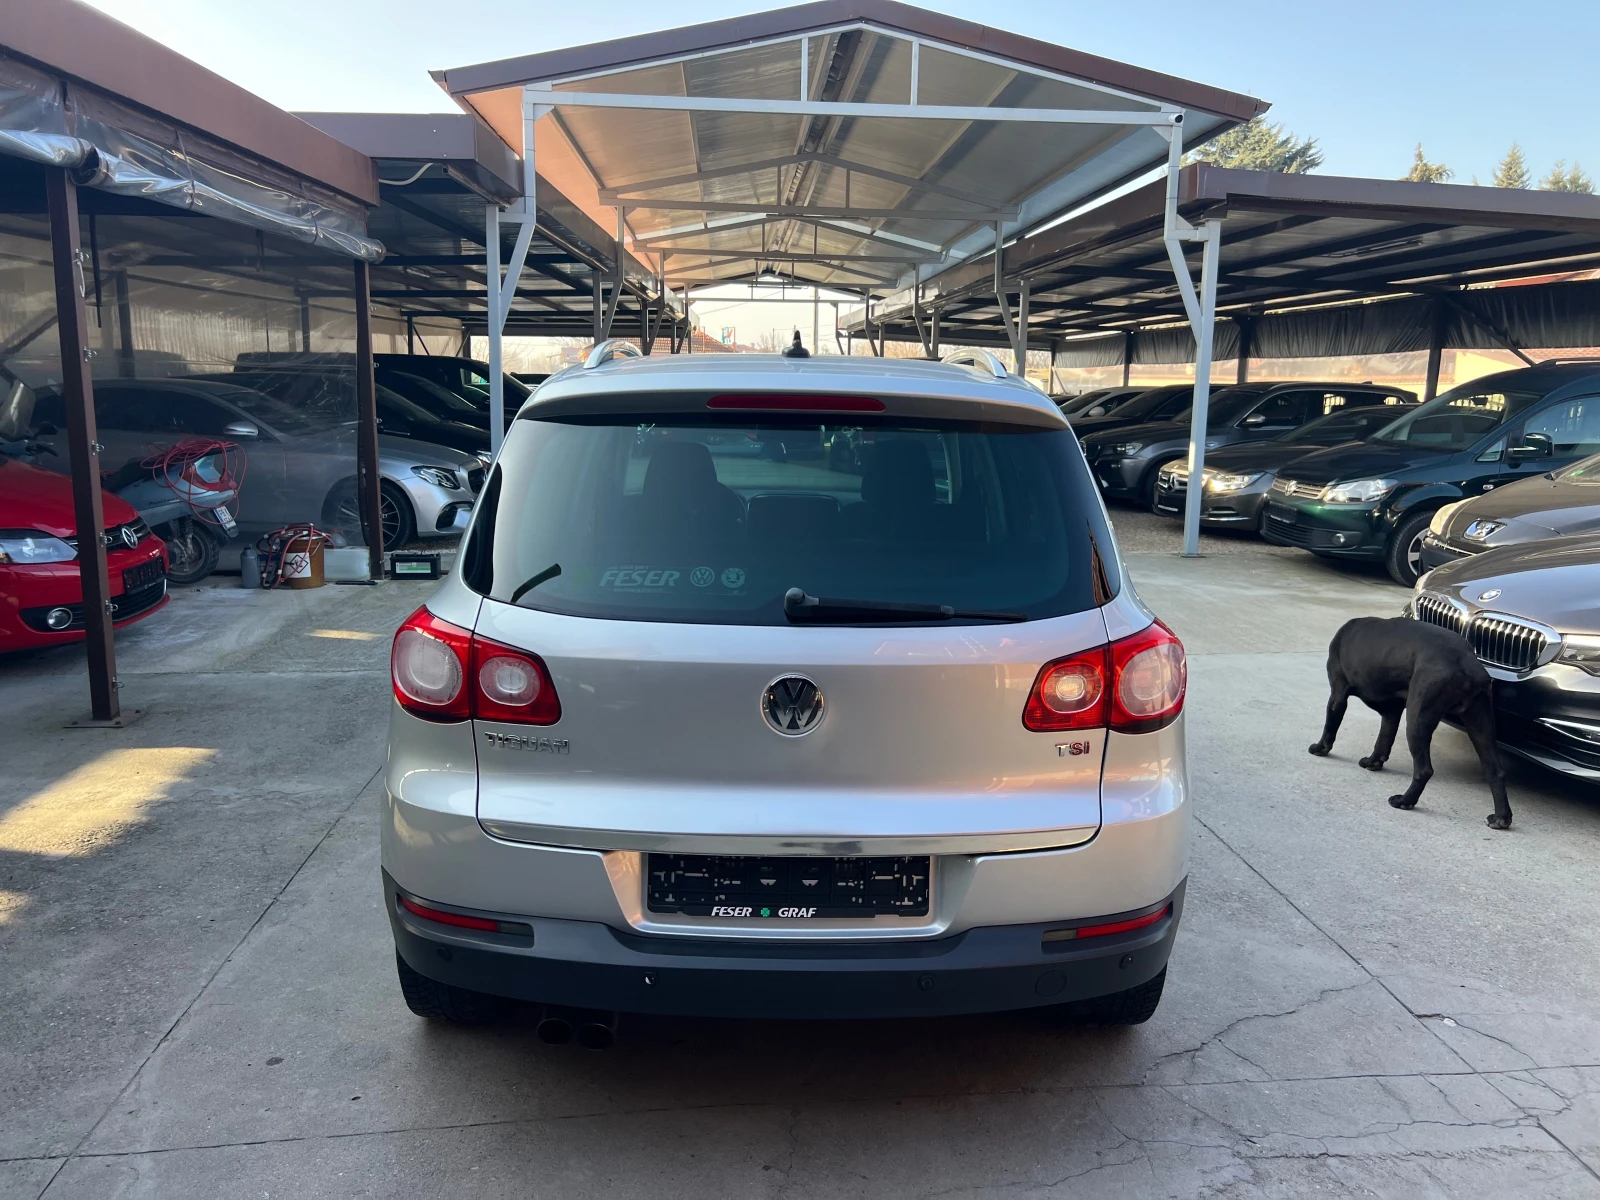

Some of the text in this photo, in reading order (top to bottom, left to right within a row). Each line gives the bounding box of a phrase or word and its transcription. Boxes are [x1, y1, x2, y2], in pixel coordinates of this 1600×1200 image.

[599, 570, 680, 587] FESER
[484, 731, 569, 755] TIGUAN
[1055, 741, 1090, 757] TSI
[711, 906, 817, 918] FESER GRAF
